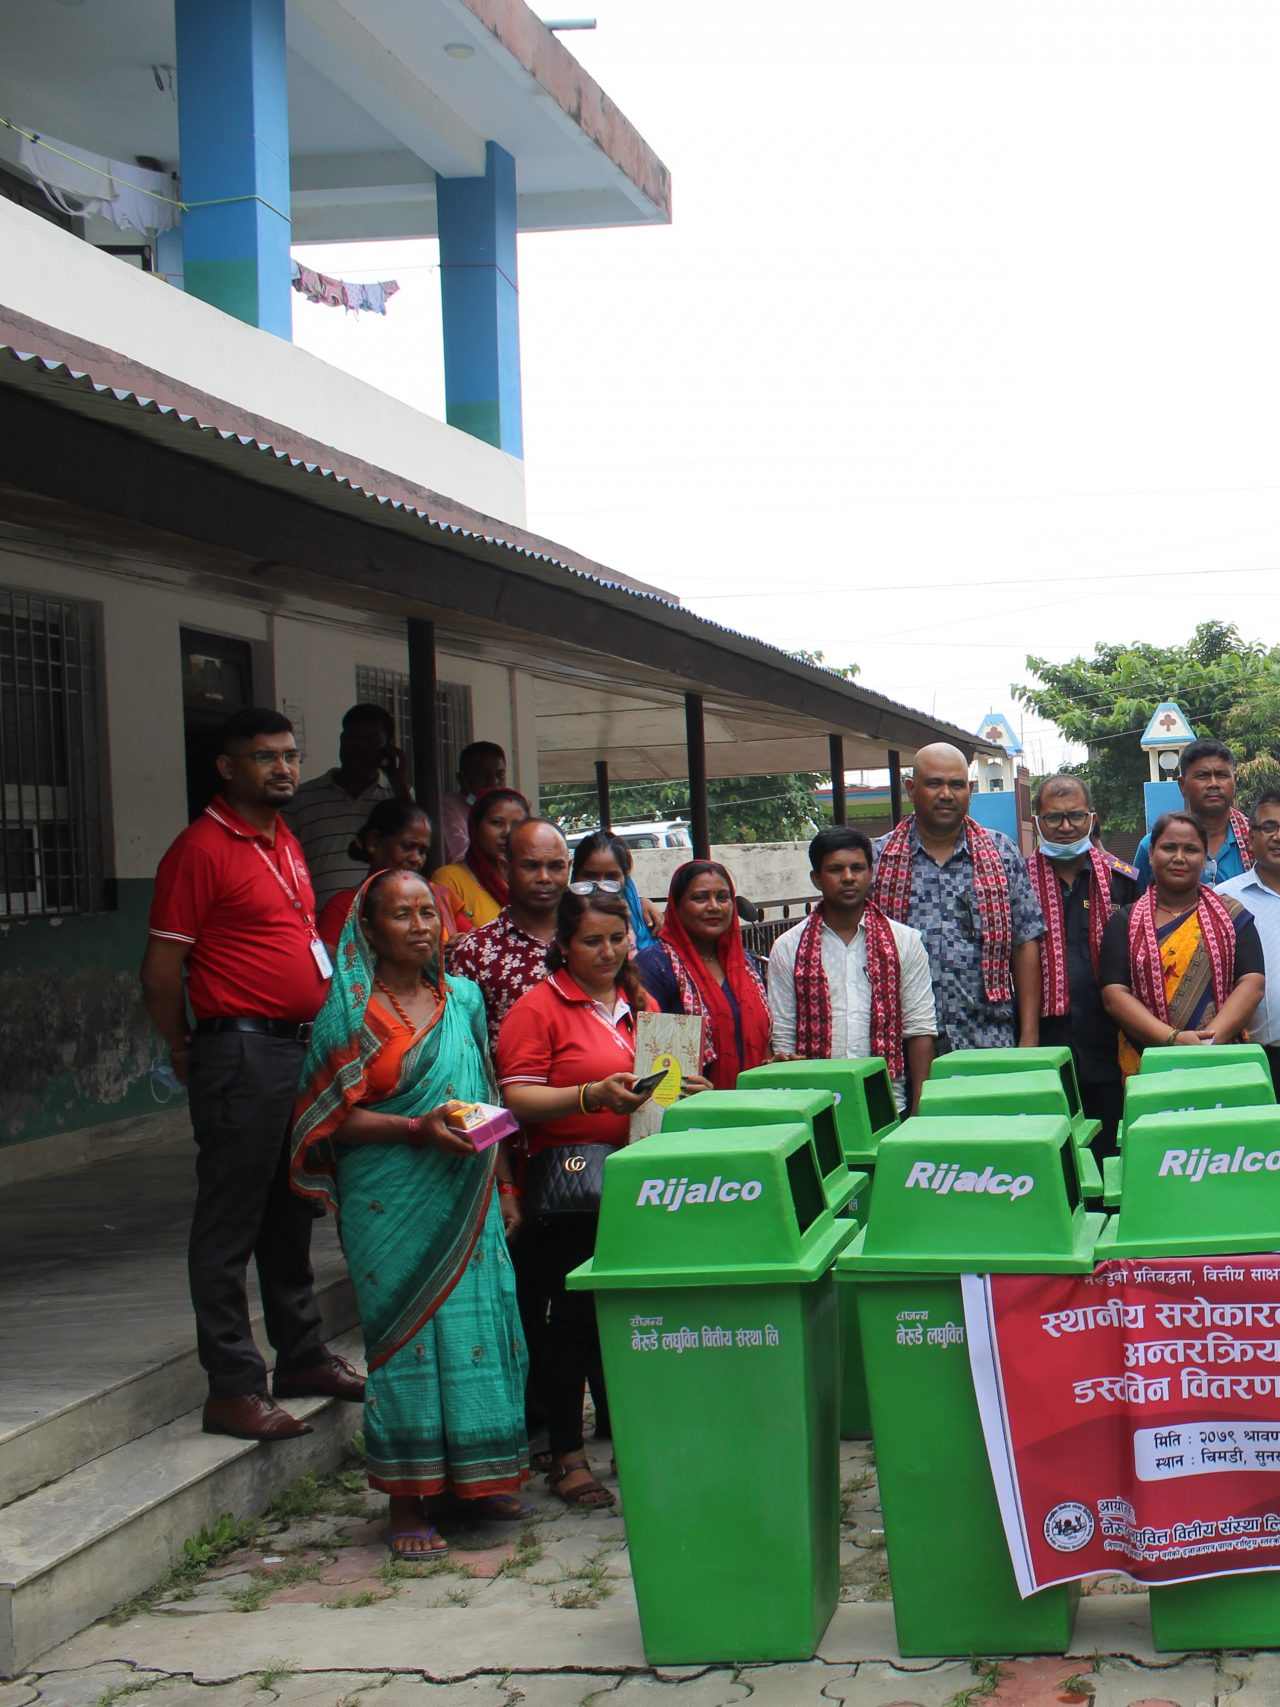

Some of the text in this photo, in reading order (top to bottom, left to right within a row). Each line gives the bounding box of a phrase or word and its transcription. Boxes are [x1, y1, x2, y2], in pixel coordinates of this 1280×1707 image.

[636, 1176, 763, 1212] Rijalco
[904, 1161, 1034, 1201] Rijalco
[1203, 1265, 1245, 1282] वित्तीय
[1040, 1298, 1146, 1338] स्थानीय
[701, 1325, 733, 1348] वित्तीय
[735, 1327, 763, 1348] संस्था
[765, 1323, 779, 1346] लि
[1153, 1430, 1182, 1449] मिति
[1199, 1430, 1237, 1444] २०७९
[1155, 1455, 1185, 1471] स्थान
[1173, 1519, 1216, 1543] वित्तीय
[1218, 1516, 1262, 1535] संस्था
